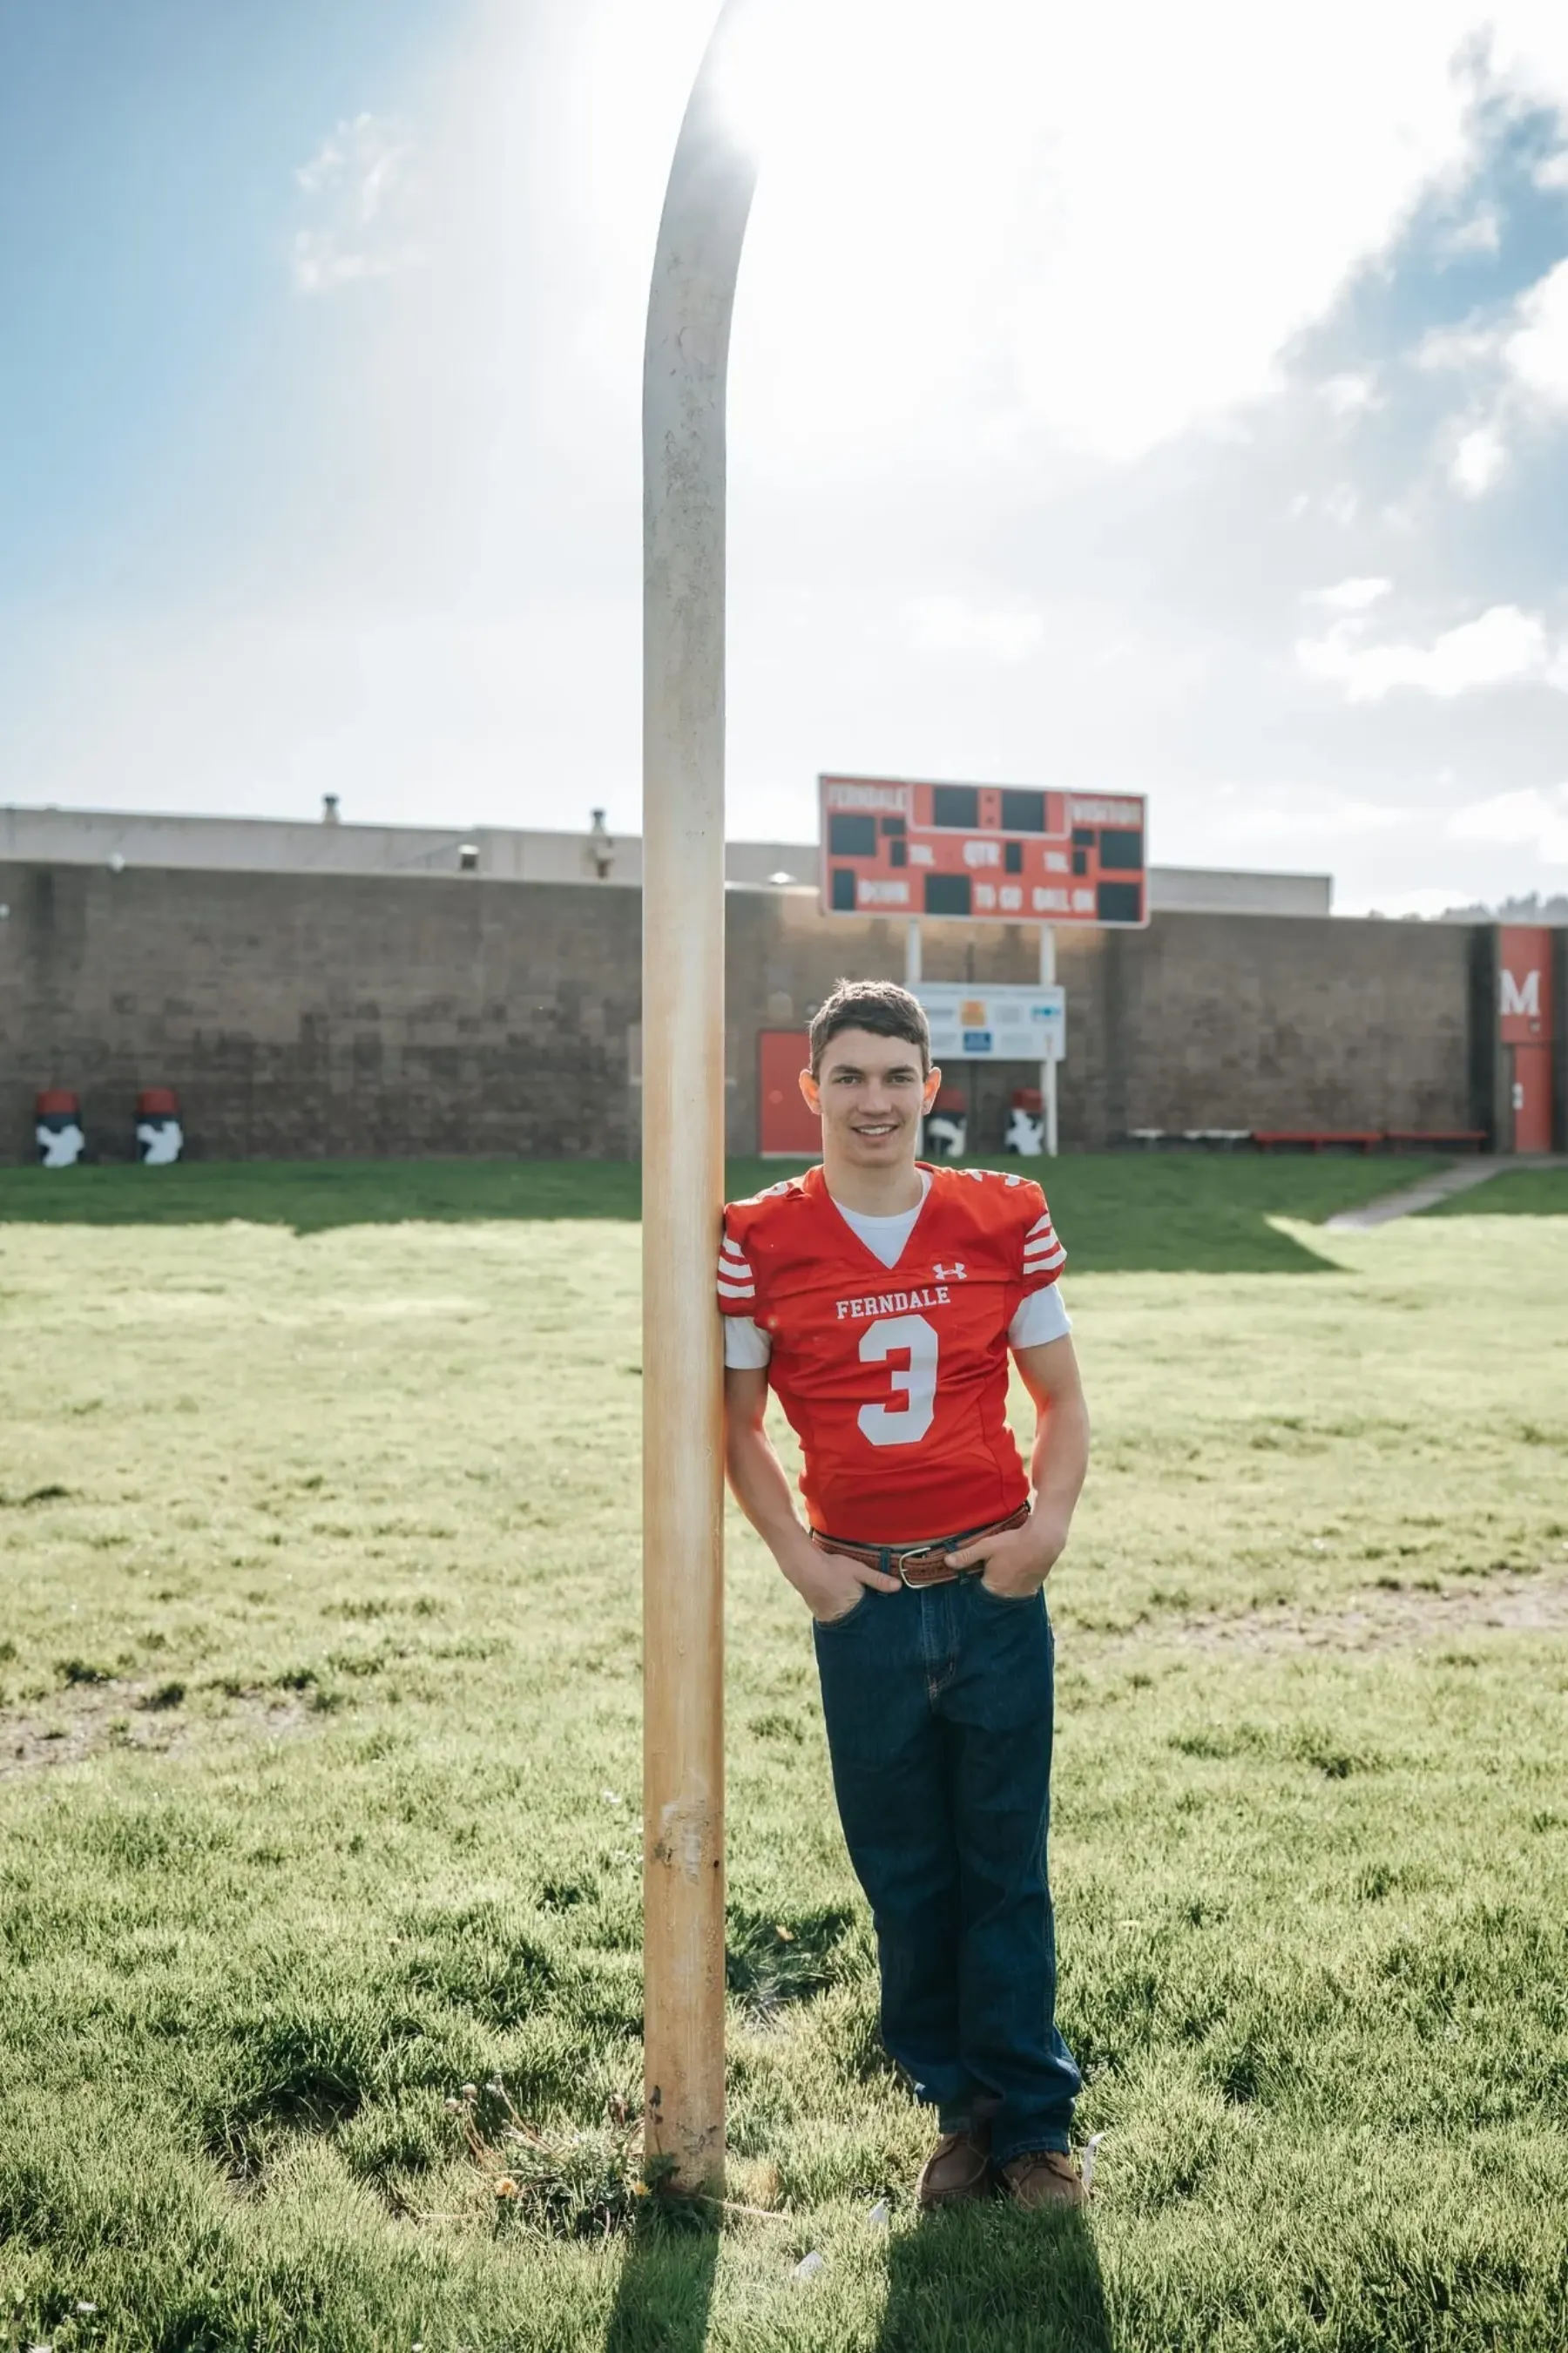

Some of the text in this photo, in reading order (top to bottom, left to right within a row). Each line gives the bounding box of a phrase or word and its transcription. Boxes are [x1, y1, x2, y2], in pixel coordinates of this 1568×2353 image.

[1500, 969, 1540, 1016] M
[836, 1287, 950, 1319] FERNDALE
[857, 1314, 938, 1446] 3
